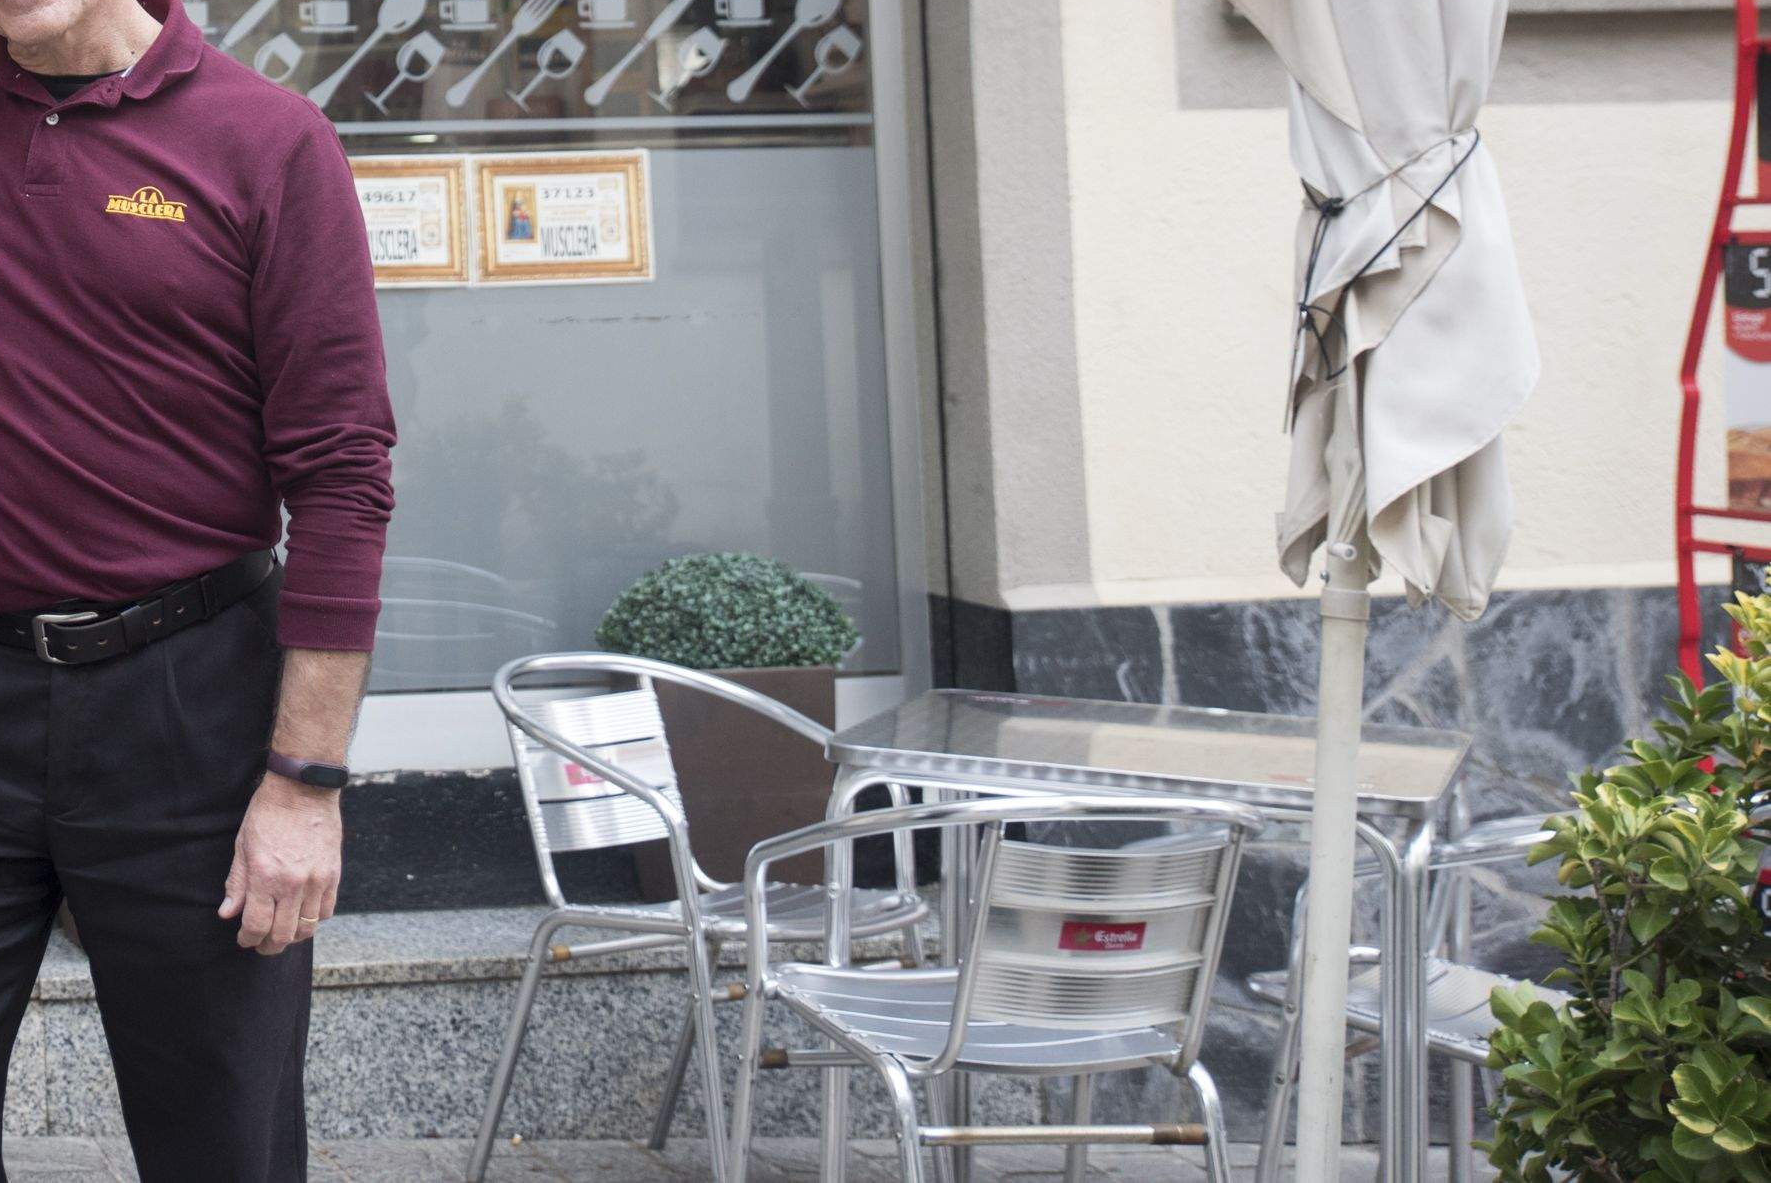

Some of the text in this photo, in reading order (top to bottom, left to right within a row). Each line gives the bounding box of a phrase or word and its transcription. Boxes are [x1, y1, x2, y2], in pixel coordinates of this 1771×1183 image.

[140, 191, 159, 204] LA
[363, 190, 416, 202] 49617
[107, 198, 185, 219] MUSCLERA
[368, 228, 418, 260] USCLERA
[541, 224, 598, 257] MUSCLERA
[1094, 929, 1139, 944] Estrella
